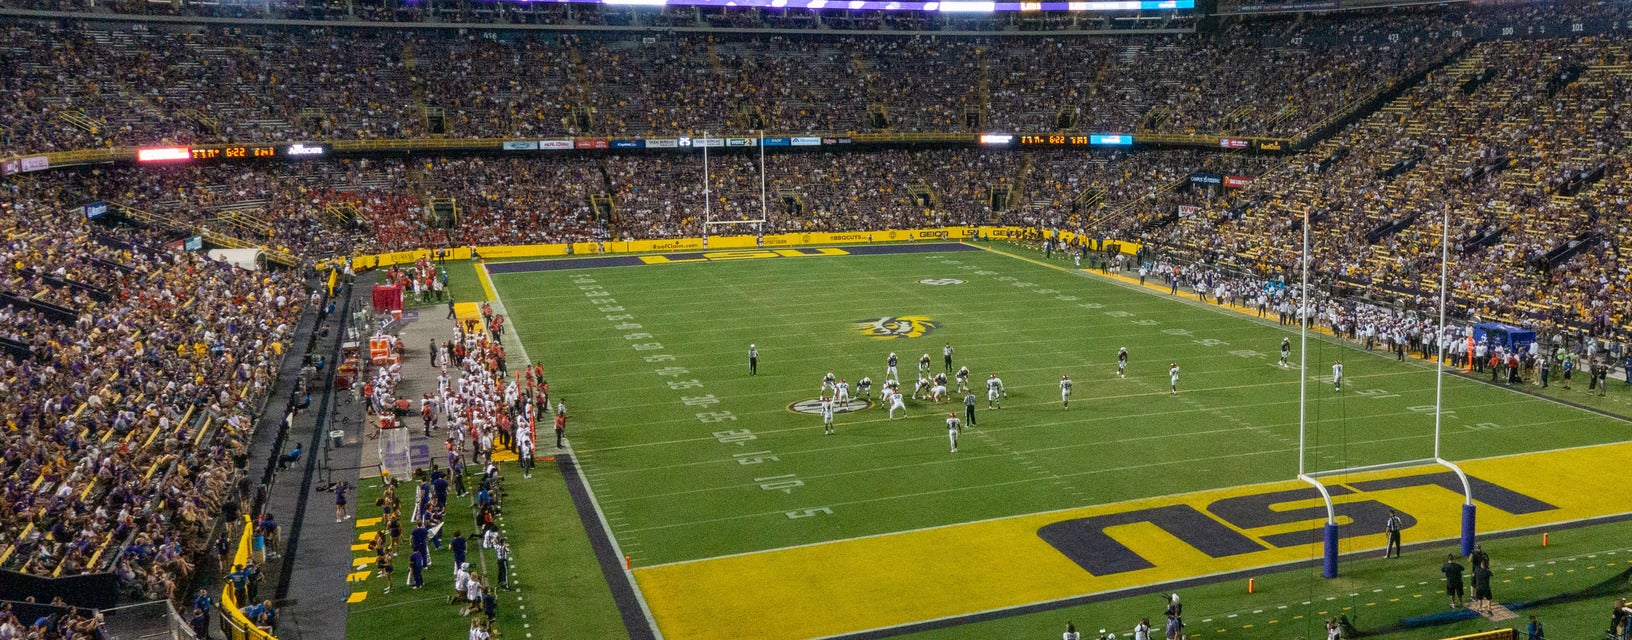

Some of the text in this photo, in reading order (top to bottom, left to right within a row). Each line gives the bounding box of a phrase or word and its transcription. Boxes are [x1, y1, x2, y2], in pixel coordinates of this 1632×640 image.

[1571, 23, 1584, 32] 101
[679, 137, 691, 146] 25
[1049, 135, 1065, 144] 6:22
[226, 147, 246, 157] 6:22
[680, 394, 720, 406] 30
[696, 411, 737, 423] 25
[712, 429, 757, 443] 20
[732, 450, 780, 465] 15
[754, 474, 805, 490] 10
[785, 507, 834, 519] 5
[1037, 472, 1561, 577] LSU
